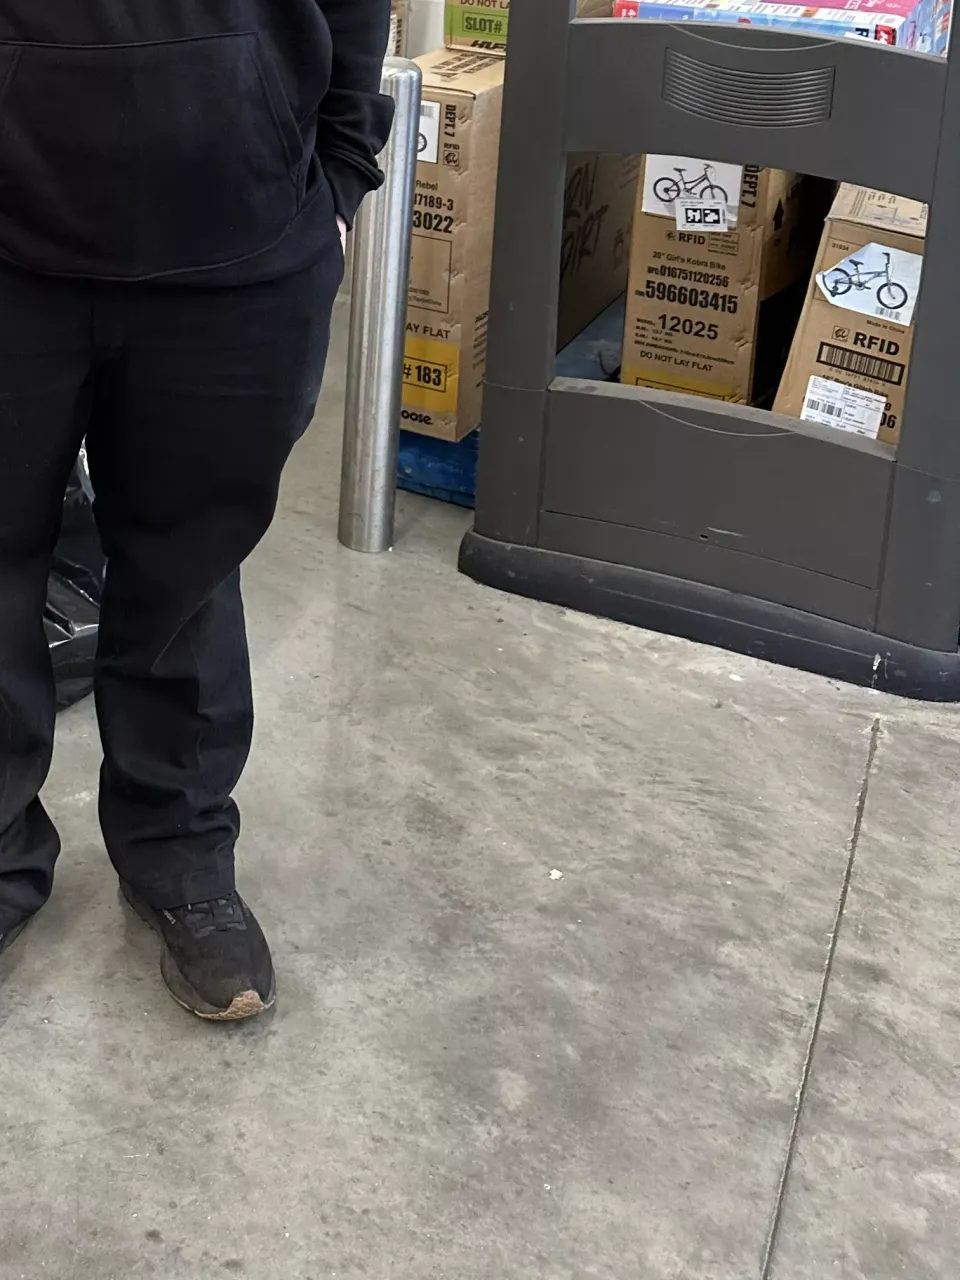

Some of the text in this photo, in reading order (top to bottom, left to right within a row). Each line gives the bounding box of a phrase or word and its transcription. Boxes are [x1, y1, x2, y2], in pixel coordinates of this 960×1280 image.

[476, 0, 498, 8] NOT
[499, 1, 510, 10] LA
[465, 16, 502, 34] SLOT#
[470, 39, 507, 51] HUF
[444, 104, 457, 130] DEPT.
[443, 142, 460, 150] RFID
[415, 179, 438, 191] Rebel
[741, 164, 760, 208] DEPT. 7
[412, 209, 453, 234] 3022
[678, 232, 706, 245] RFID
[652, 251, 726, 271] 20" Girl's Kobra Bike
[660, 264, 729, 288] 016751120256
[645, 279, 739, 314] 596603415
[405, 323, 451, 340] AY FLAT
[658, 313, 719, 340] 12025
[866, 319, 882, 328] Made
[888, 325, 905, 334] China
[852, 331, 900, 356] RFID
[640, 350, 714, 372] DO NOT LAY FLAT
[415, 363, 442, 387] 183
[401, 409, 433, 425] oose
